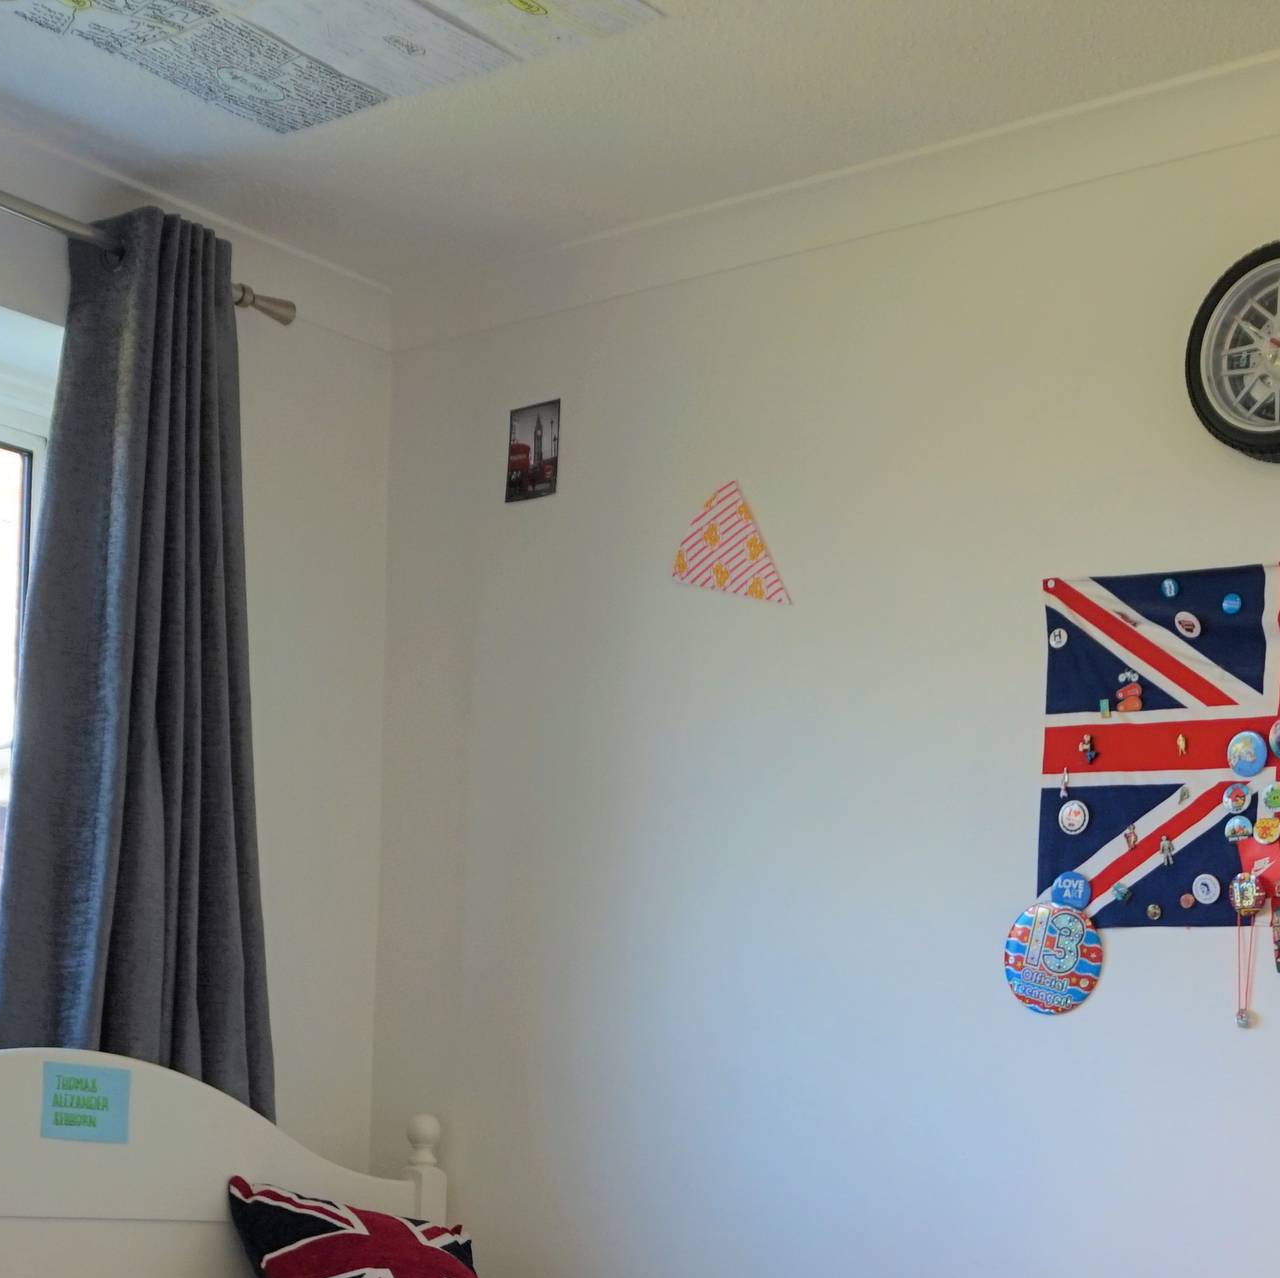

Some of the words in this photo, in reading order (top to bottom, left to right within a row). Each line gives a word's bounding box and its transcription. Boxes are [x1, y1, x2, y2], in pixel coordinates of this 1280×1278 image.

[1058, 879, 1085, 890] LOVE
[1063, 888, 1084, 899] ART
[1025, 905, 1085, 975] 13
[1022, 968, 1068, 992] Official
